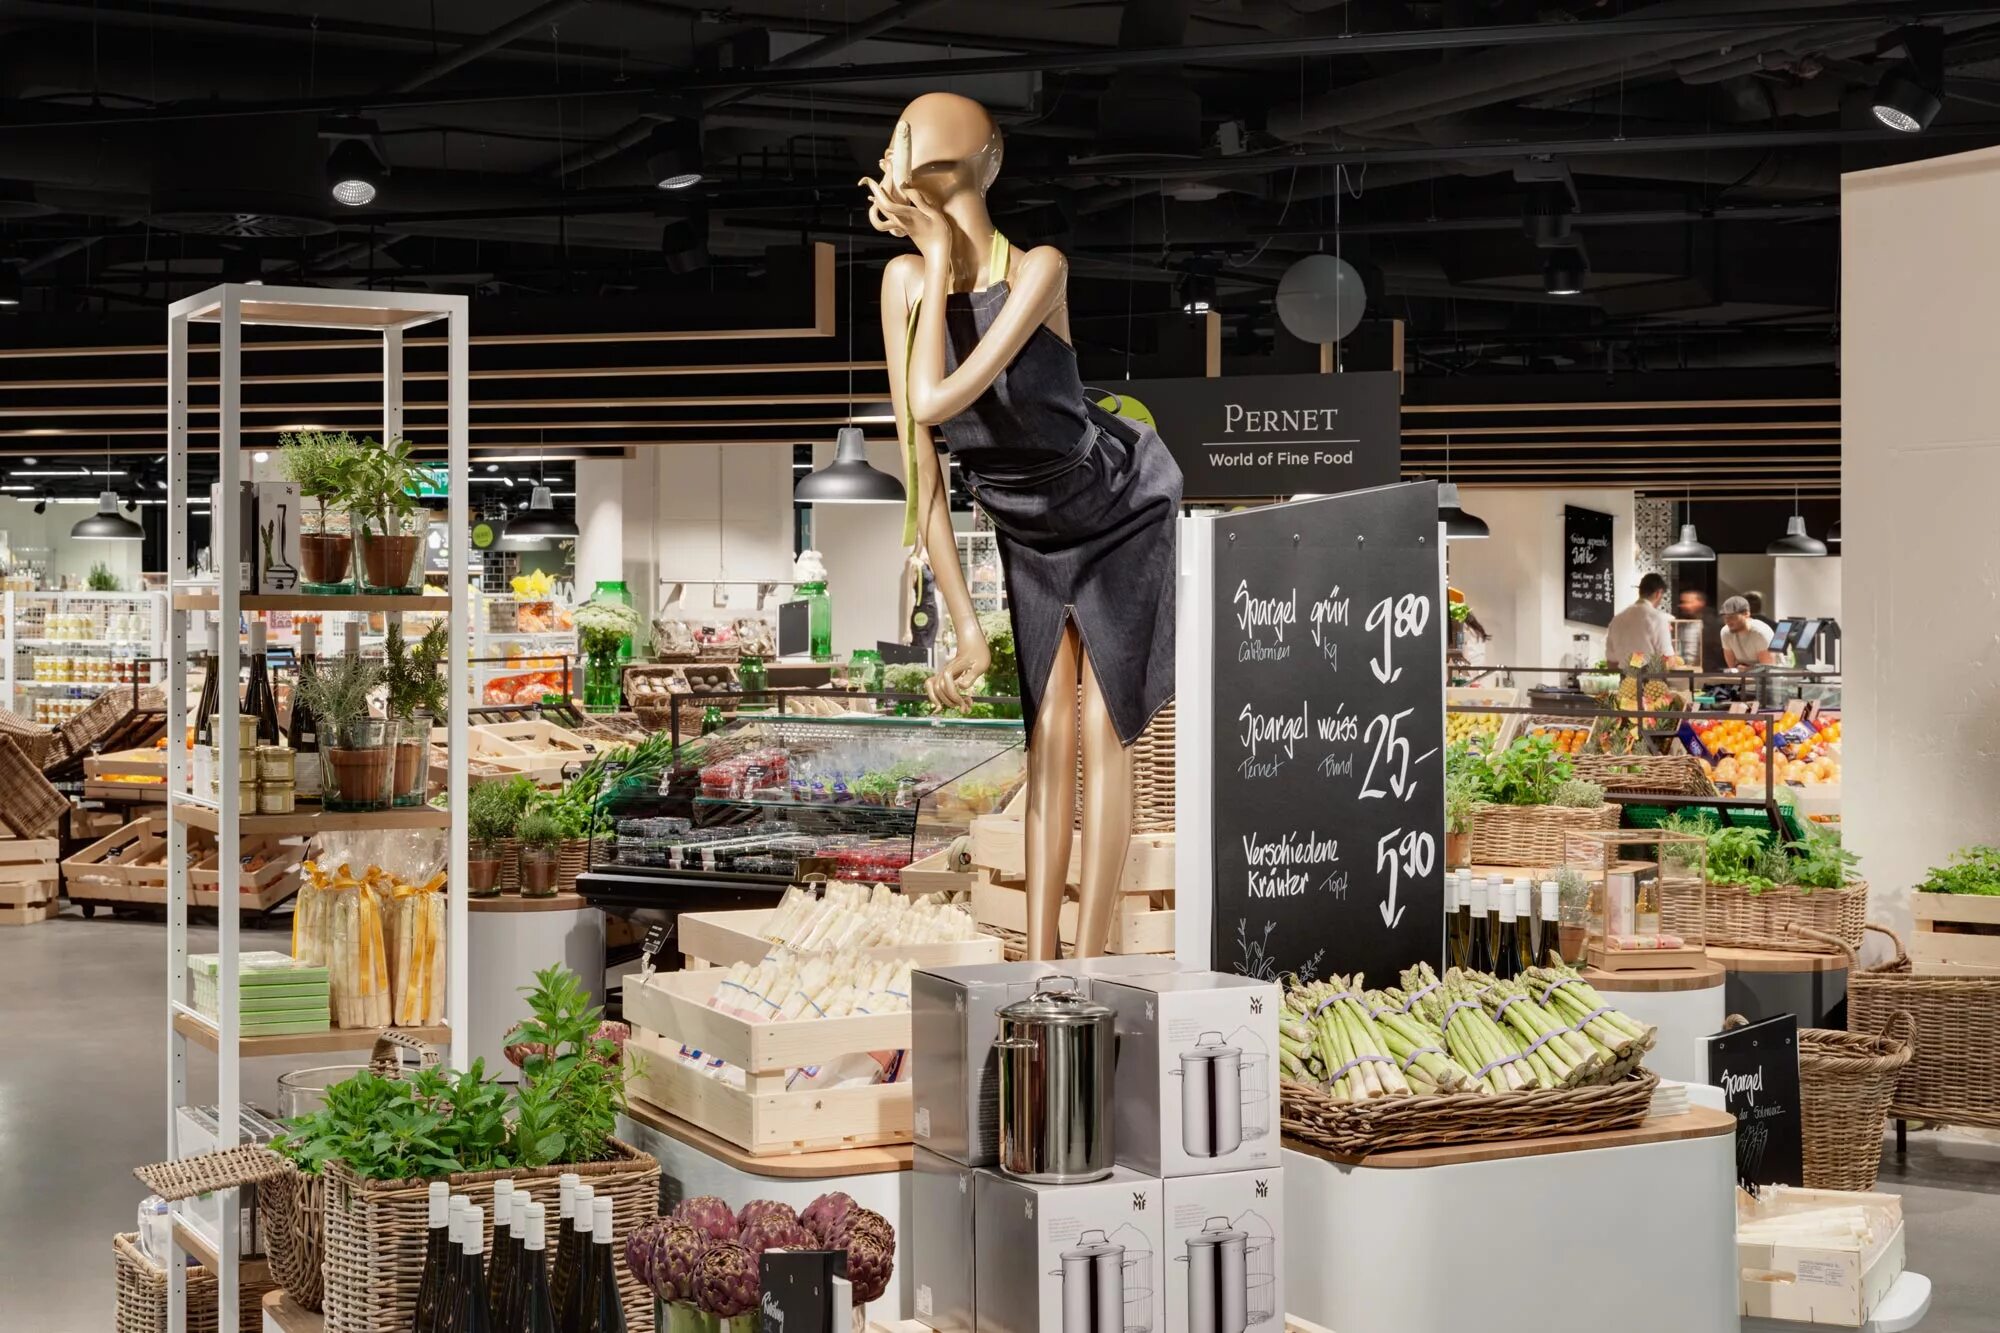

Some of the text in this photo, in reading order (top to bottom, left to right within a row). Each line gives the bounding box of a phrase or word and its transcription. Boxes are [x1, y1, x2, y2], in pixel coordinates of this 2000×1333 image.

[1224, 404, 1338, 433] PERNET
[1209, 450, 1353, 467] World of Fine Food
[1234, 579, 1296, 642] Spargel
[1310, 585, 1350, 647] grün
[1324, 636, 1337, 672] kg
[1238, 700, 1308, 759] Spargel
[1317, 702, 1358, 742] weiss
[1243, 830, 1340, 866] Verschiedene
[1721, 1065, 1763, 1107] Spargel
